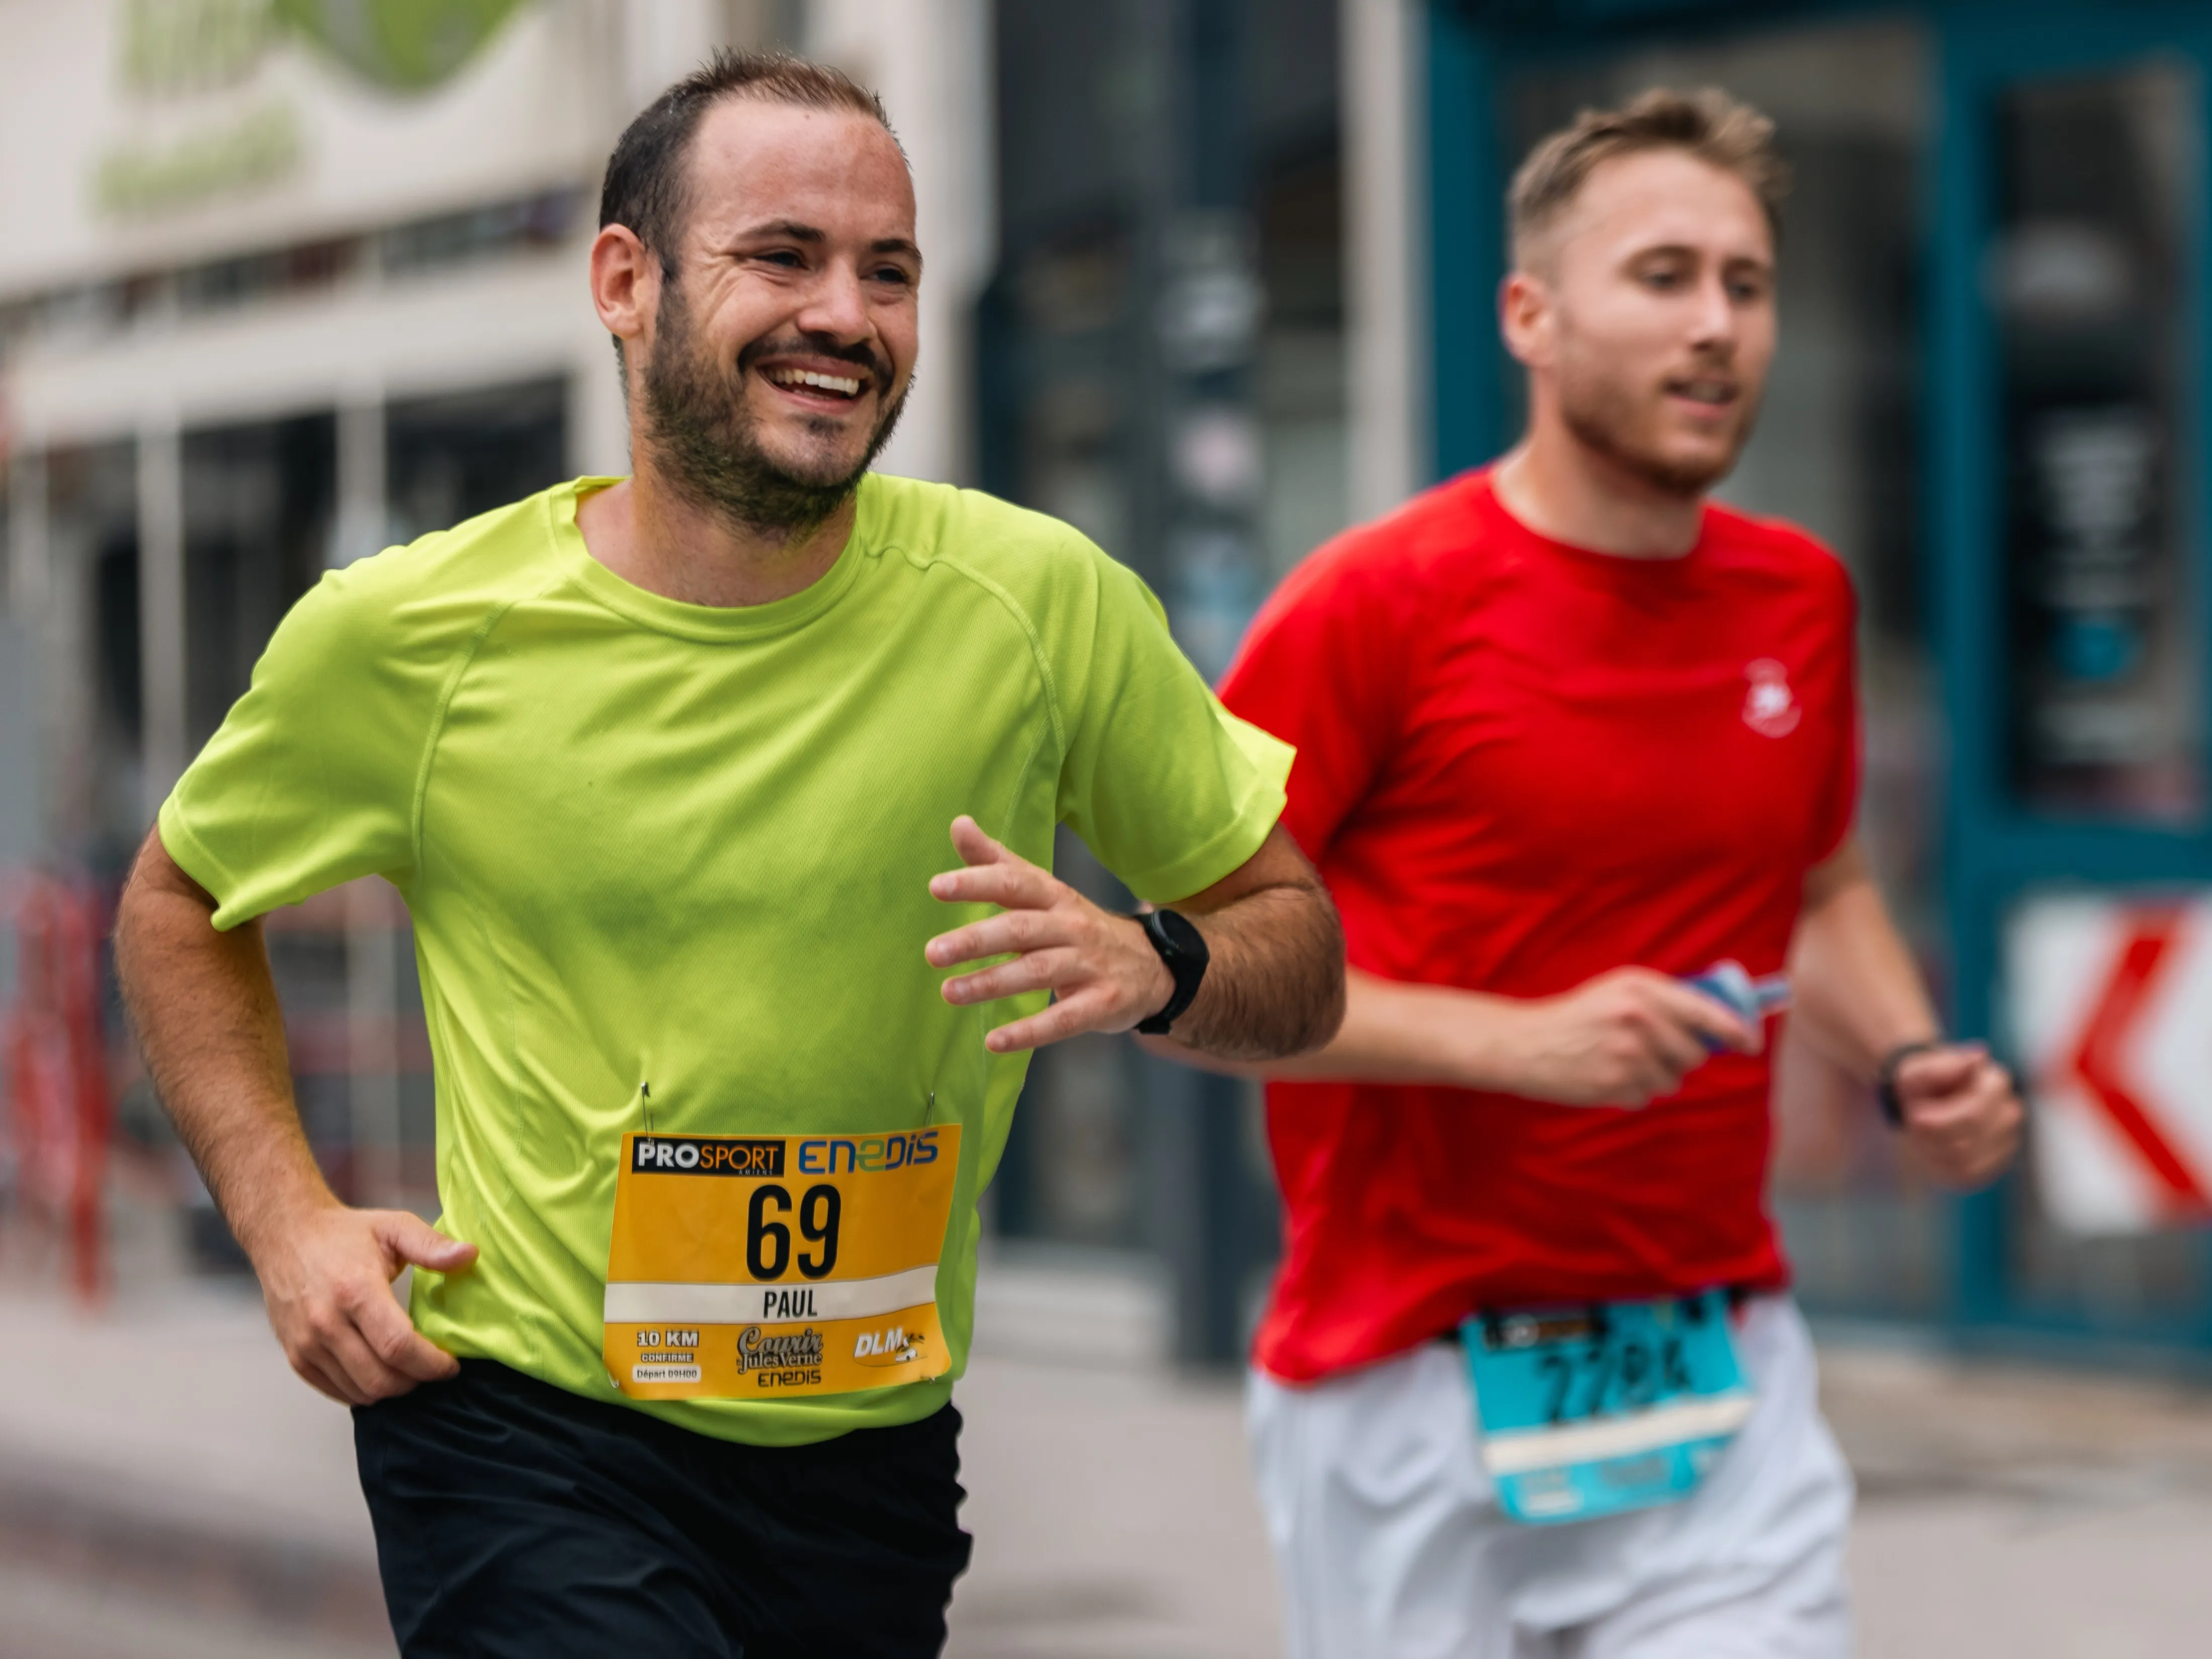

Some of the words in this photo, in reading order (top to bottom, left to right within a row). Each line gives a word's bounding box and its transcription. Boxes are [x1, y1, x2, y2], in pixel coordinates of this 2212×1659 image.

[746, 1184, 841, 1281] 69
[763, 1290, 817, 1319] PAUL
[638, 1331, 660, 1347] 10
[666, 1331, 699, 1347] KM
[737, 1327, 823, 1355] Courir
[854, 1327, 903, 1358] DLM
[641, 1353, 694, 1363] CONFIRME
[637, 1368, 665, 1380] Départ
[668, 1369, 697, 1378] 09H00
